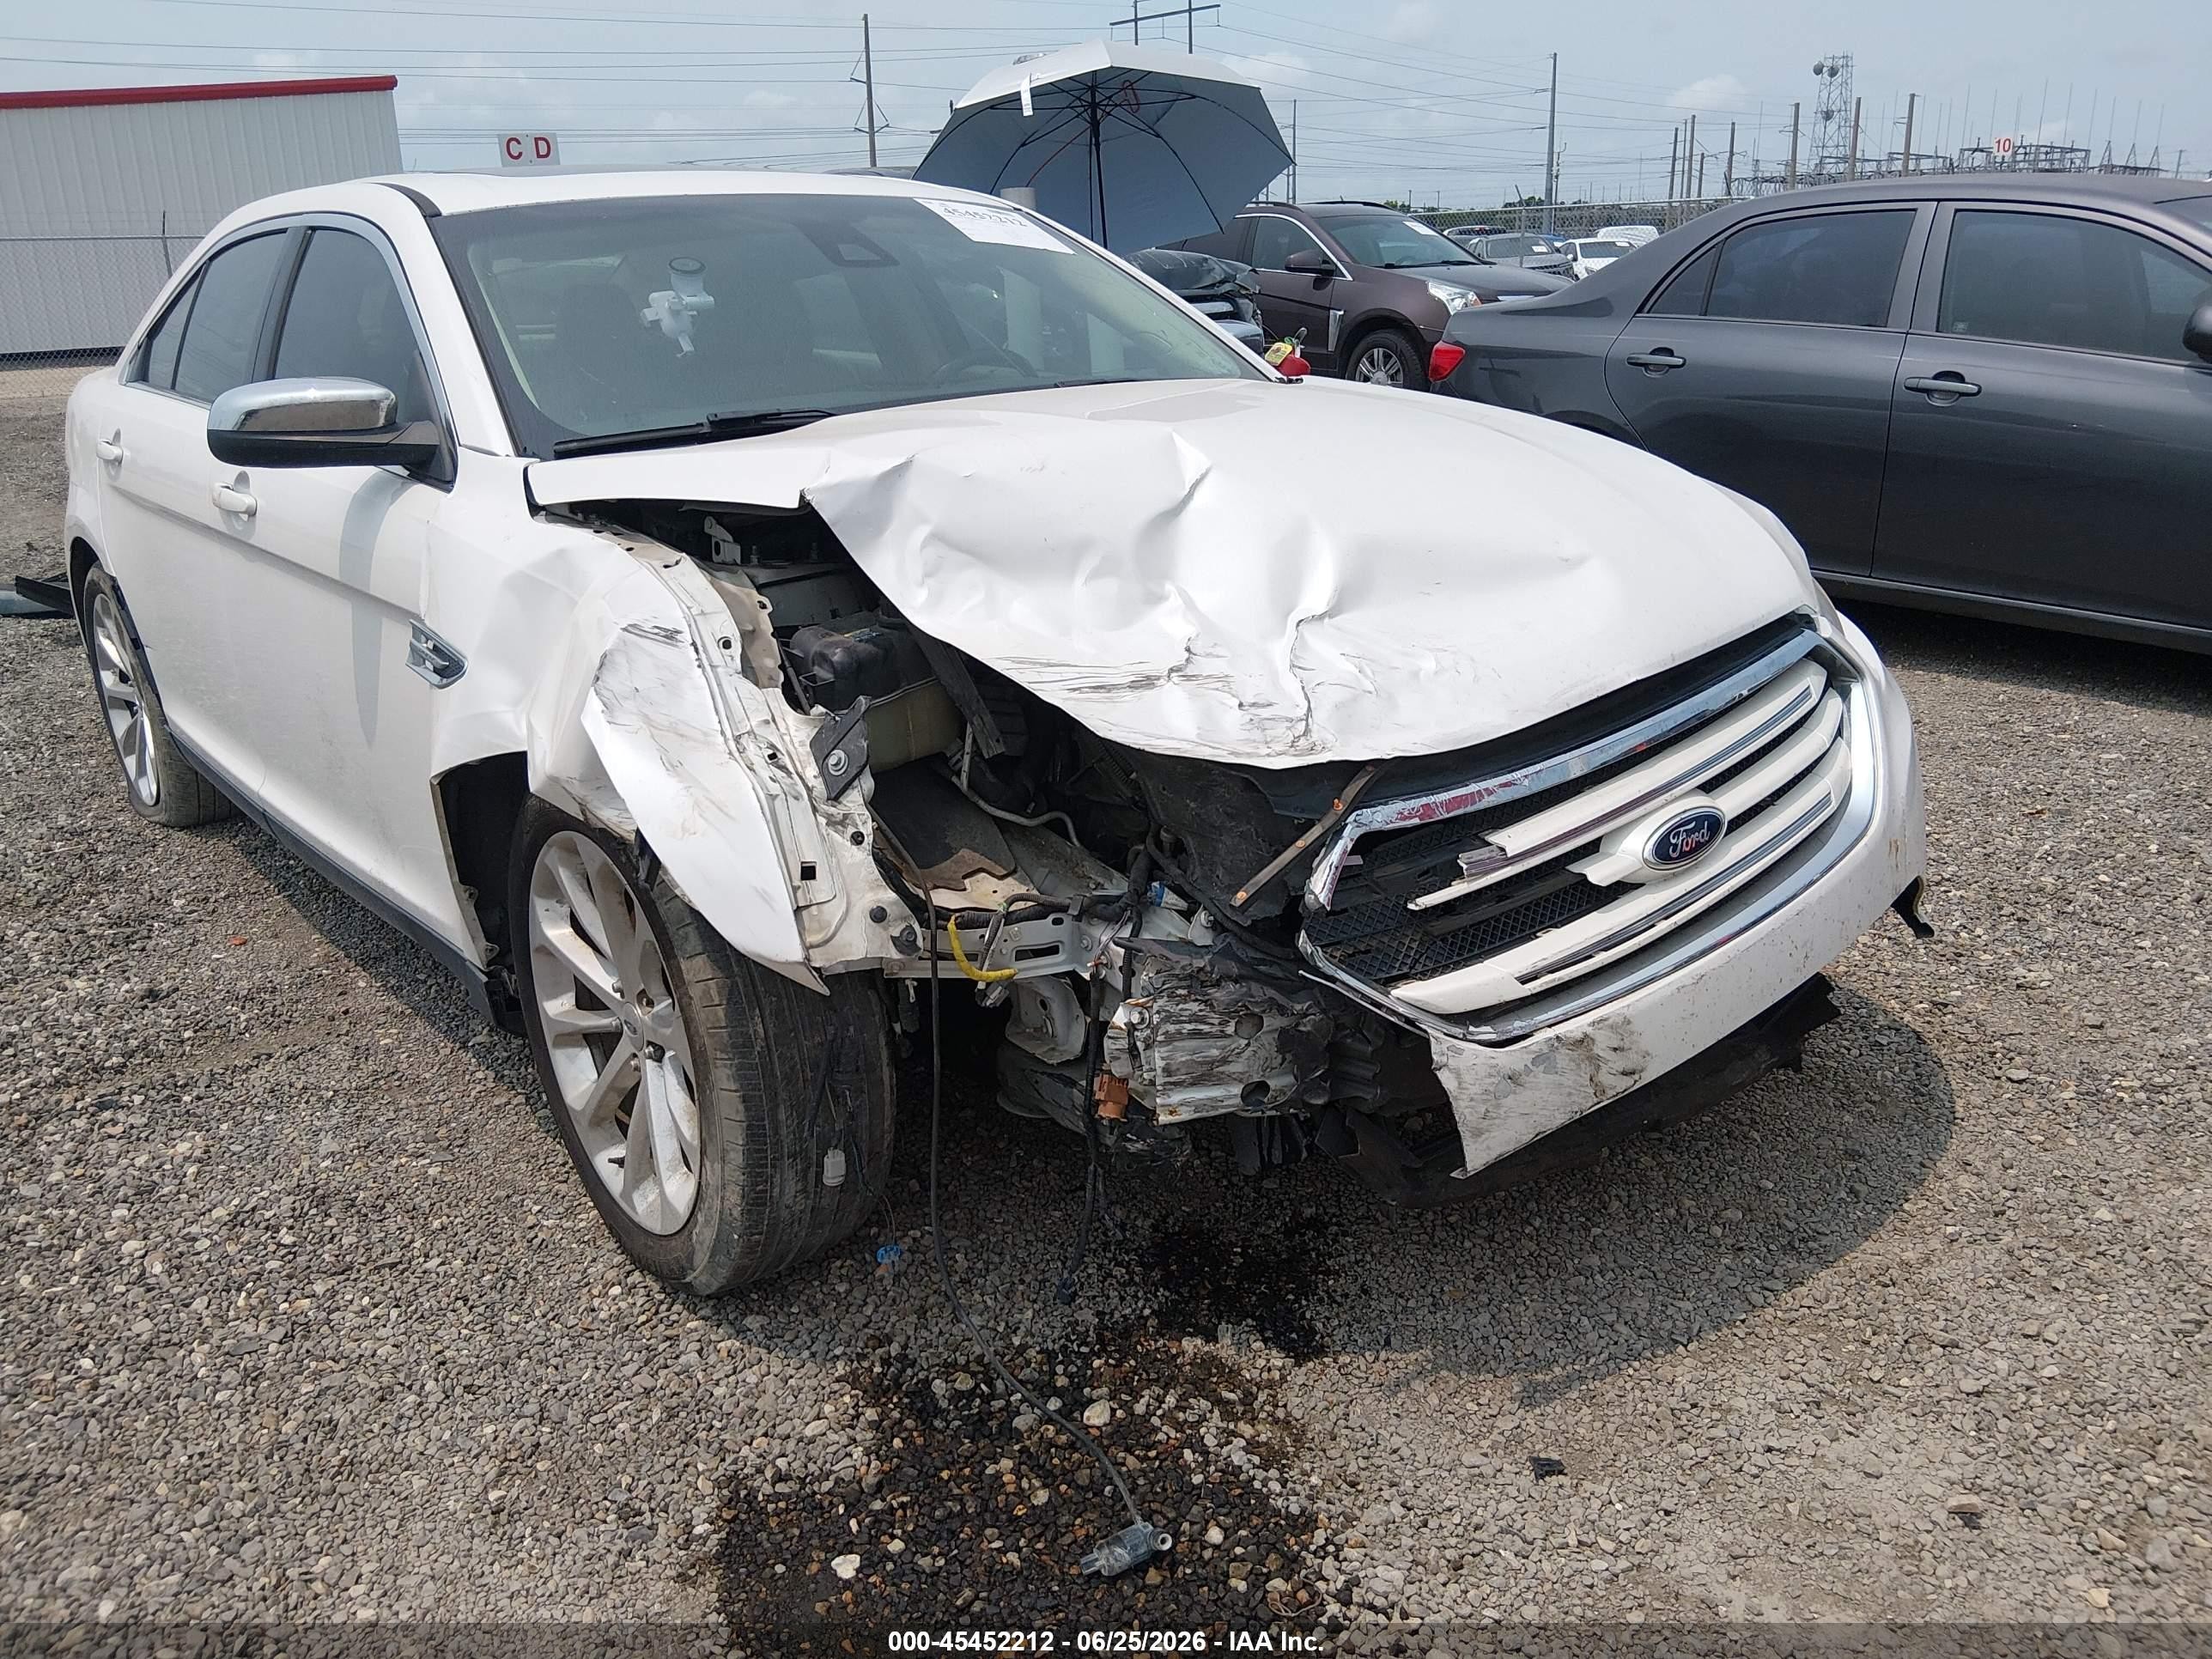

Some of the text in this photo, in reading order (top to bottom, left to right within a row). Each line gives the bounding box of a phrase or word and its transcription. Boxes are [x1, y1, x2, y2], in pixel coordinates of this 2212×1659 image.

[506, 137, 552, 161] C D
[1995, 138, 2012, 154] 10
[1668, 820, 1710, 858] Ford
